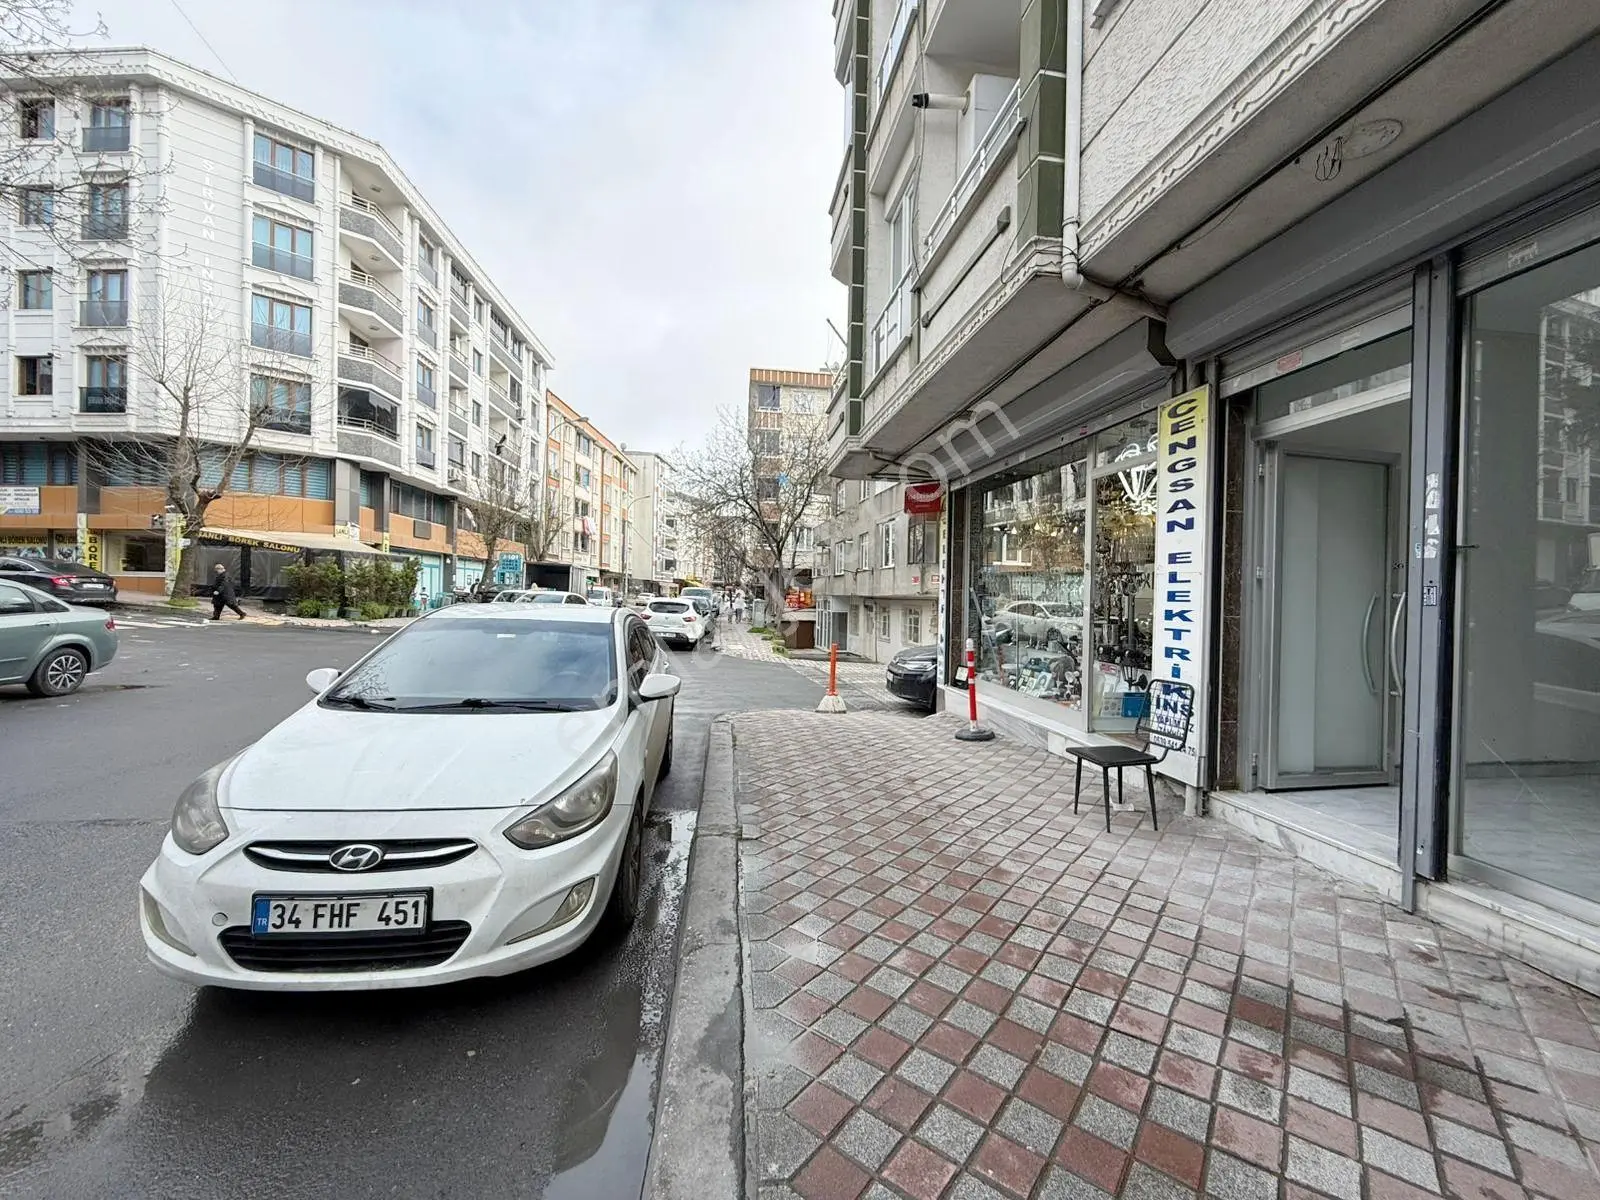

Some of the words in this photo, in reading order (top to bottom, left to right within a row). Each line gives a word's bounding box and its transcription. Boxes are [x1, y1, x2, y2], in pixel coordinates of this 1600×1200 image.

[1166, 398, 1199, 533] CENGSAN
[263, 541, 300, 553] SALONU
[1162, 551, 1195, 700] ELEKTRİK
[256, 917, 268, 926] TR
[271, 903, 302, 930] 34
[312, 902, 361, 929] FHF
[377, 899, 420, 926] 451
